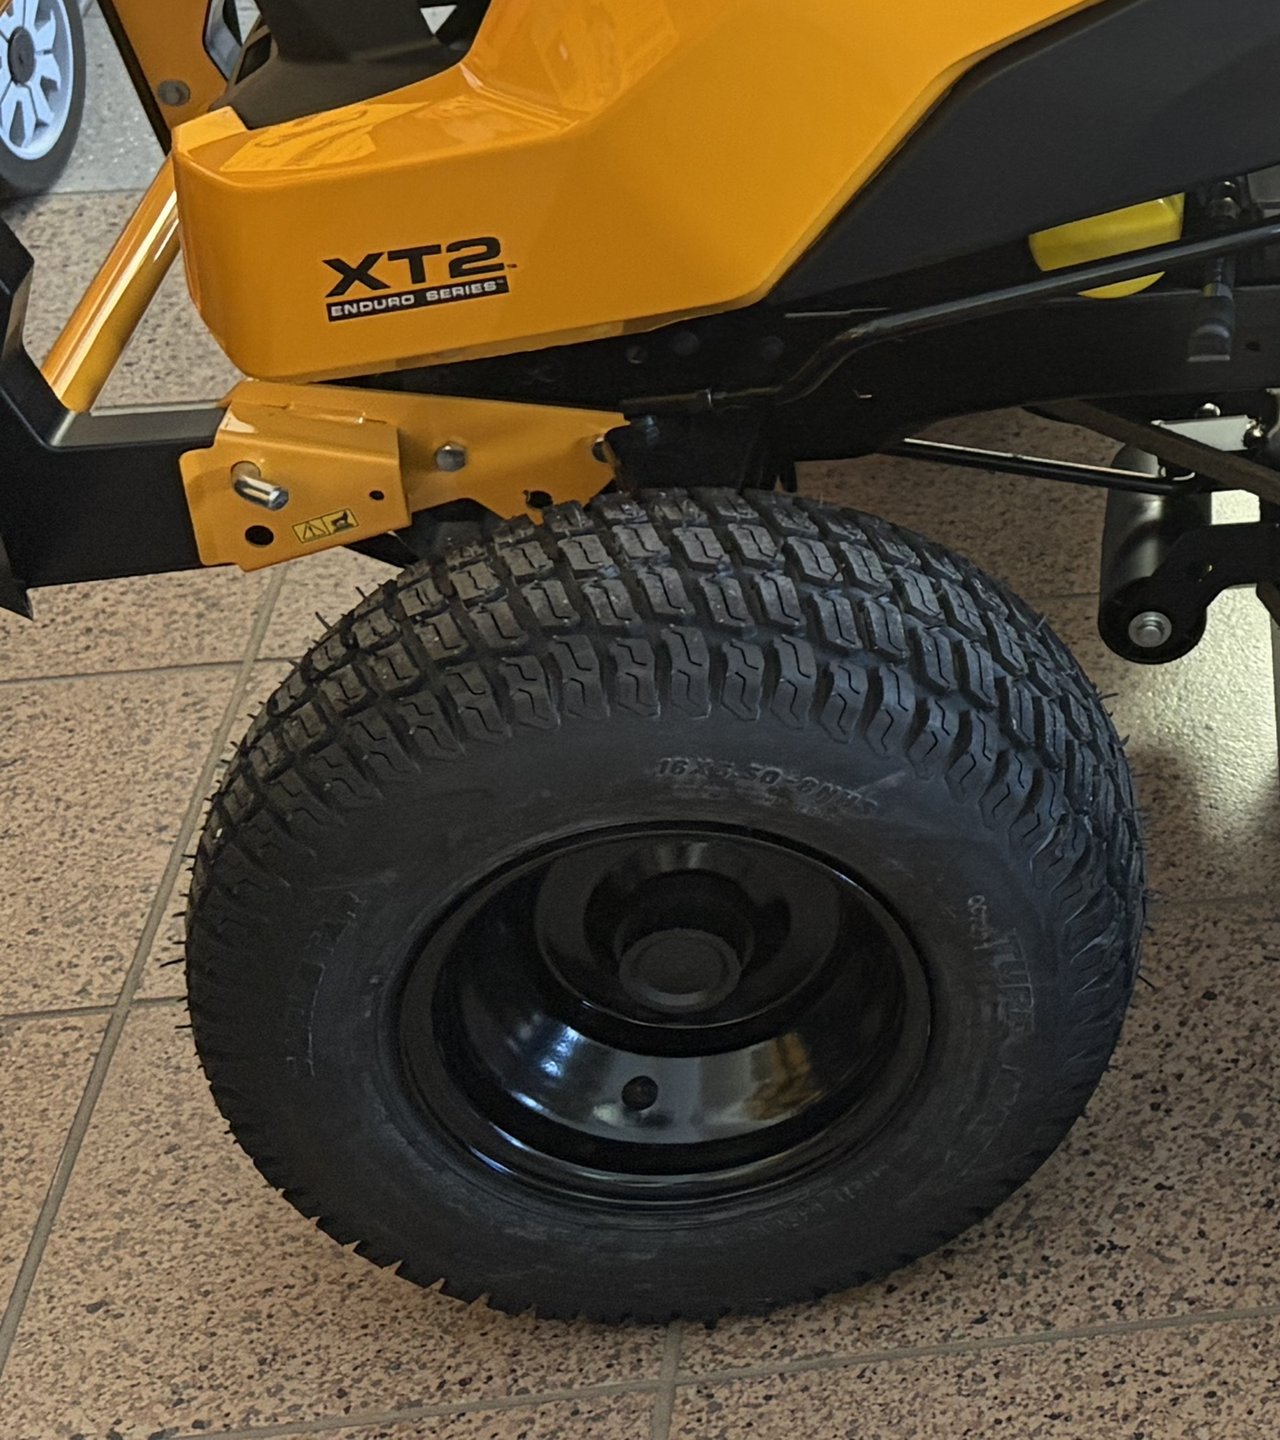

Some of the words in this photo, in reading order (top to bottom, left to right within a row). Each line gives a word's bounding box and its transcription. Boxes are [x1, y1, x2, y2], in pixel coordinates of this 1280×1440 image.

[322, 236, 505, 298] XT2
[331, 293, 416, 318] ENDURO
[425, 279, 498, 302] SERIES
